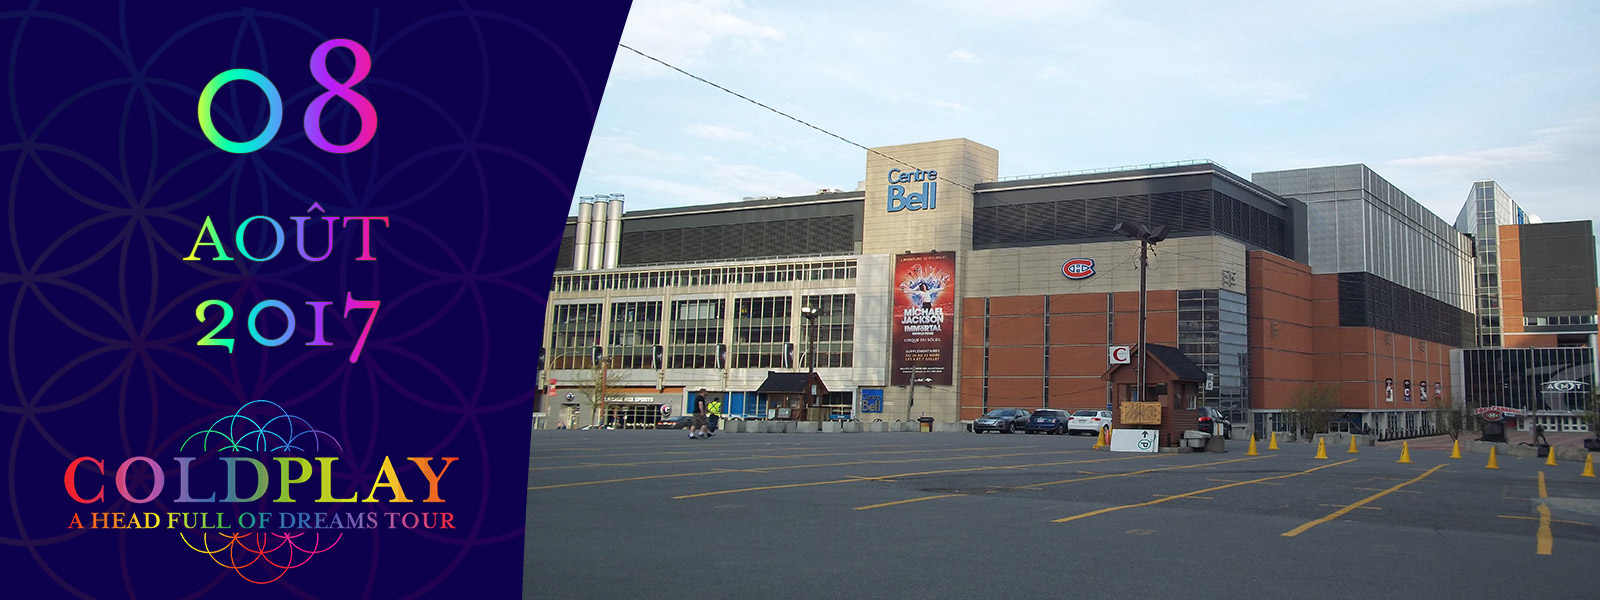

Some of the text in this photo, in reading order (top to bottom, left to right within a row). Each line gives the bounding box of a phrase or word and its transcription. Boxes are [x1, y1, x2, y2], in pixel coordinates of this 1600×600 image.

[888, 168, 938, 184] Centre
[887, 182, 937, 212] Bell
[904, 307, 943, 316] MICHAEL
[901, 315, 944, 324] JACKSON
[904, 324, 942, 332] IMMORTAL
[1113, 348, 1127, 362] C
[862, 400, 881, 412] Bell
